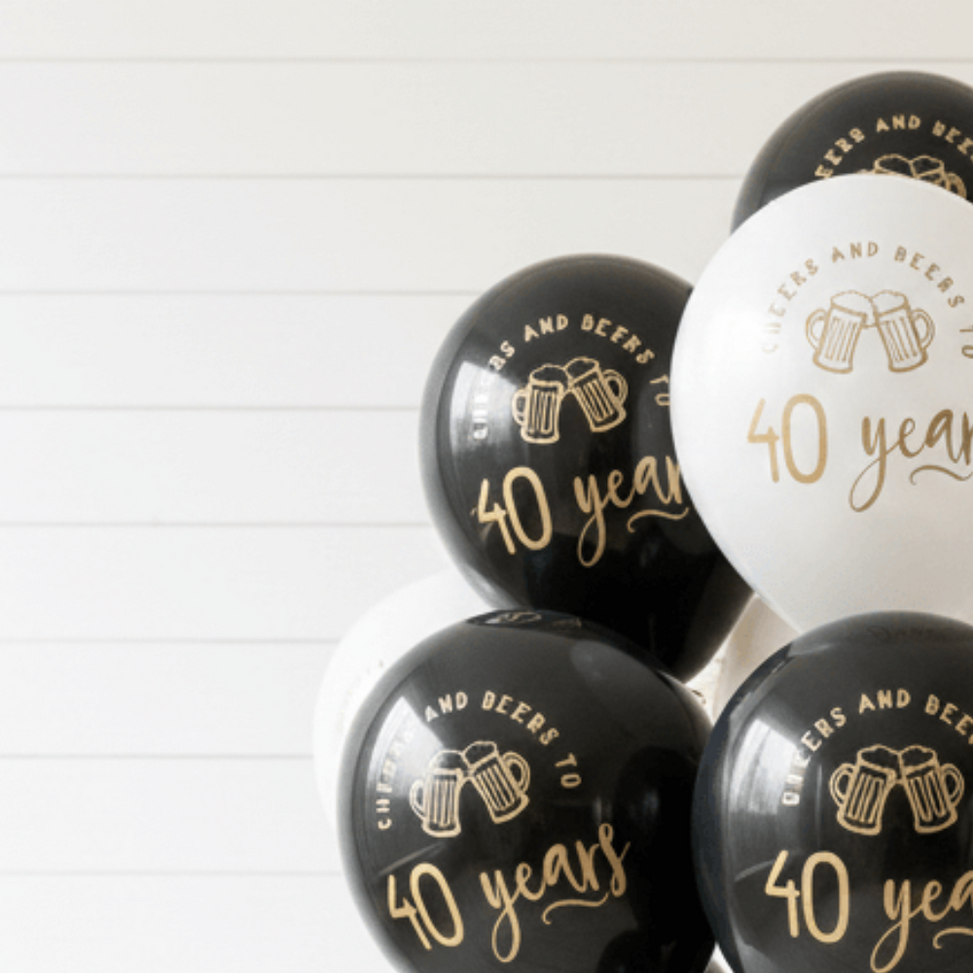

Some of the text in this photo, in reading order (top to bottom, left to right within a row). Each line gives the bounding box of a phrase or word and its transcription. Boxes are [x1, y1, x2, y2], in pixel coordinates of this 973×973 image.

[814, 127, 865, 179] EERS
[876, 113, 922, 133] AND
[831, 241, 879, 263] AND
[894, 245, 965, 308] BEERS
[524, 313, 569, 342] AND
[580, 313, 655, 364] BEERS
[747, 393, 828, 484] 40
[476, 455, 684, 567] 40 year
[424, 691, 468, 722] AND
[481, 689, 560, 746] BEERS
[554, 752, 582, 789] TO
[858, 688, 911, 714] AND
[387, 822, 631, 963] 40 years
[764, 850, 849, 943] 40
